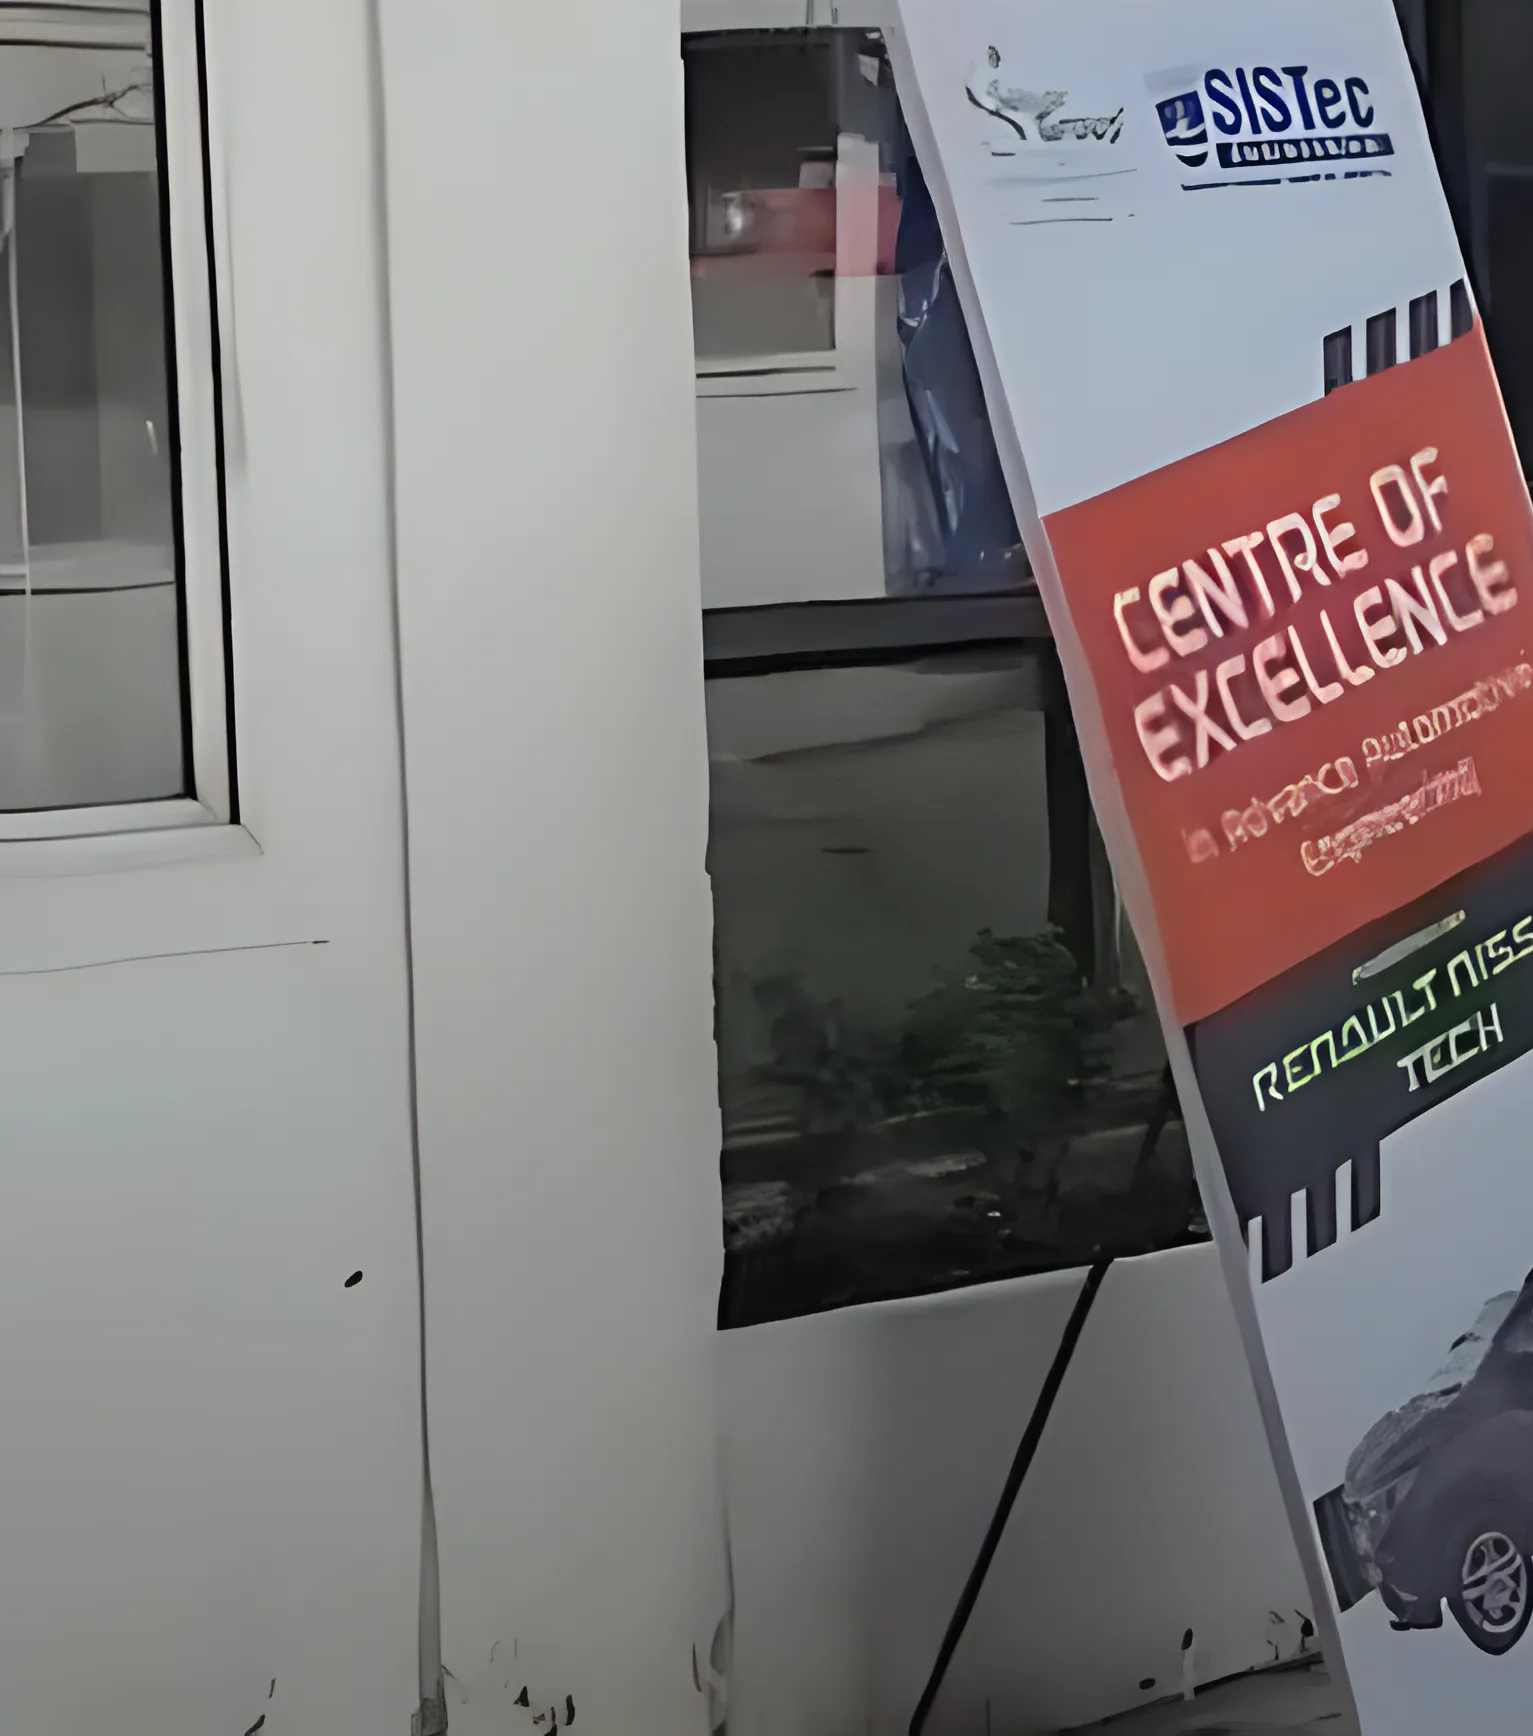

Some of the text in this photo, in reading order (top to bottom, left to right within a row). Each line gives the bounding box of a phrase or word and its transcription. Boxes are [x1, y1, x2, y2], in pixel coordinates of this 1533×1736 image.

[1204, 66, 1374, 135] SISTec
[1113, 446, 1448, 672] CENTRE OF
[1133, 533, 1517, 782] EXCELLENCE
[1253, 968, 1436, 1112] RENAULT
[1397, 1002, 1503, 1092] TECH
